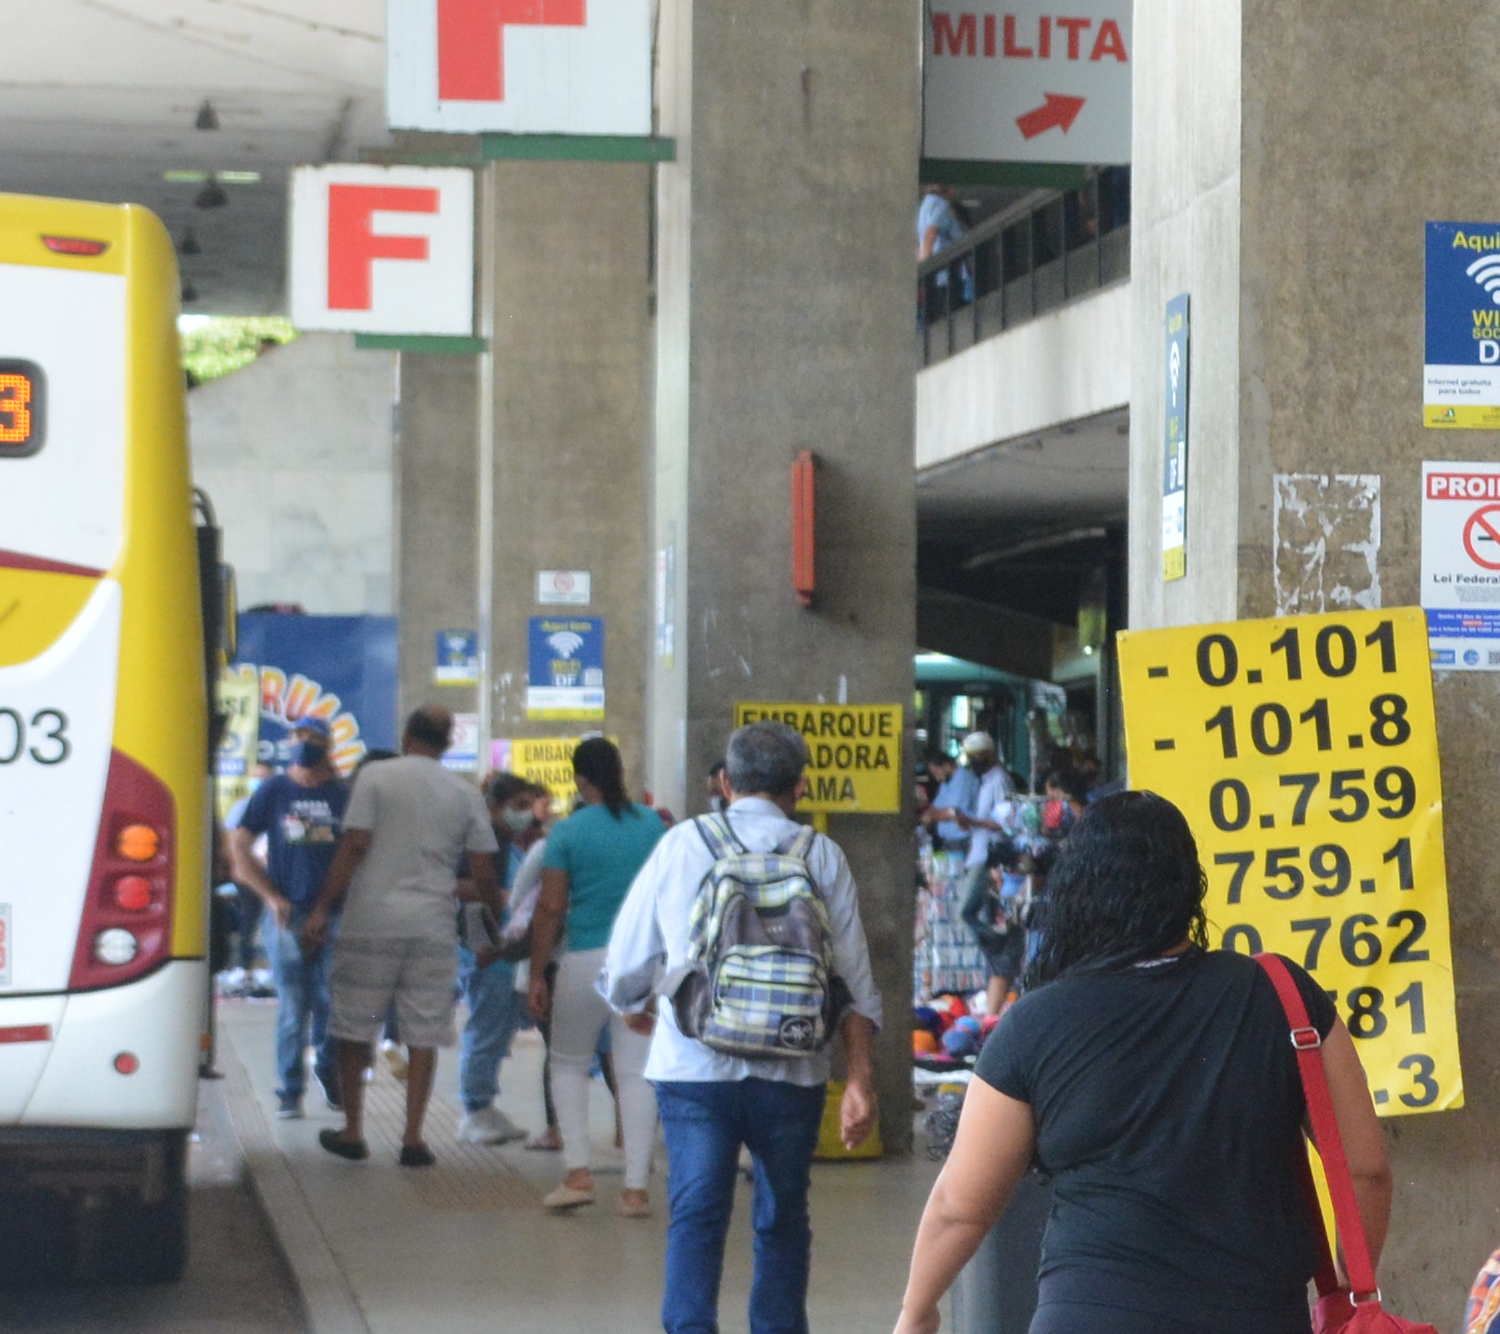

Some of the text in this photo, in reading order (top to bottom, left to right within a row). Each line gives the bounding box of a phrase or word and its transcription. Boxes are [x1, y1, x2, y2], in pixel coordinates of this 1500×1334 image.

[934, 13, 1128, 62] MILITA
[328, 183, 440, 310] F
[1452, 231, 1500, 253] Aqui
[1428, 377, 1459, 387] Internet
[1458, 387, 1481, 396] todos
[1433, 573, 1452, 583] Lei
[1196, 620, 1398, 687] 0.101
[1205, 693, 1412, 759] 101.8
[801, 776, 857, 802] AMA
[1209, 765, 1417, 832] 0.759
[1214, 838, 1416, 905] 759.1
[1220, 909, 1431, 971] 0762
